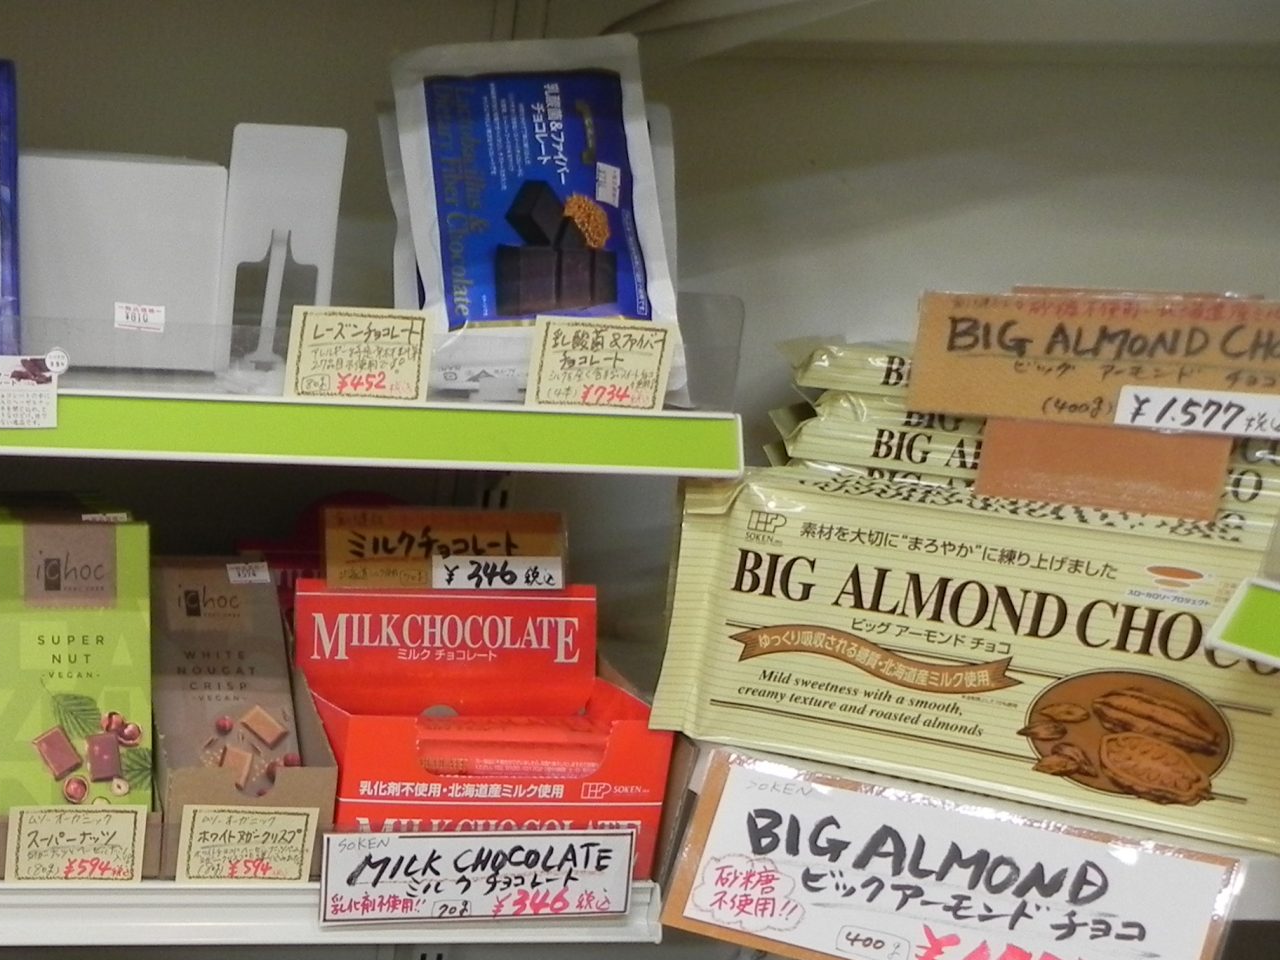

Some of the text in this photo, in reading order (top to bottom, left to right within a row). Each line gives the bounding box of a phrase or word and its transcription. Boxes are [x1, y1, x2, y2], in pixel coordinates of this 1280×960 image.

[946, 316, 1033, 357] BIG
[1046, 322, 1209, 359] ALMOND
[581, 385, 630, 404] ¥734
[870, 428, 932, 464] BIG
[347, 528, 521, 558] ミルクチョコレート
[730, 546, 1280, 677] BIG ALMOND CHO
[38, 635, 105, 646] SUPER
[850, 616, 1012, 656] ビッグ アーモンド チョコ
[52, 654, 91, 664] NUT
[177, 665, 257, 676] NOUGAT
[184, 650, 246, 661] WHITE
[189, 681, 248, 691] CRISP
[758, 668, 963, 717] Mild sweetness with a smooth,
[738, 685, 984, 738] creamy texture and roasted almonds
[347, 843, 613, 885] MILK CHOCOLATE
[746, 808, 1110, 904] BIG ALMOND
[713, 865, 781, 894] 砂糖
